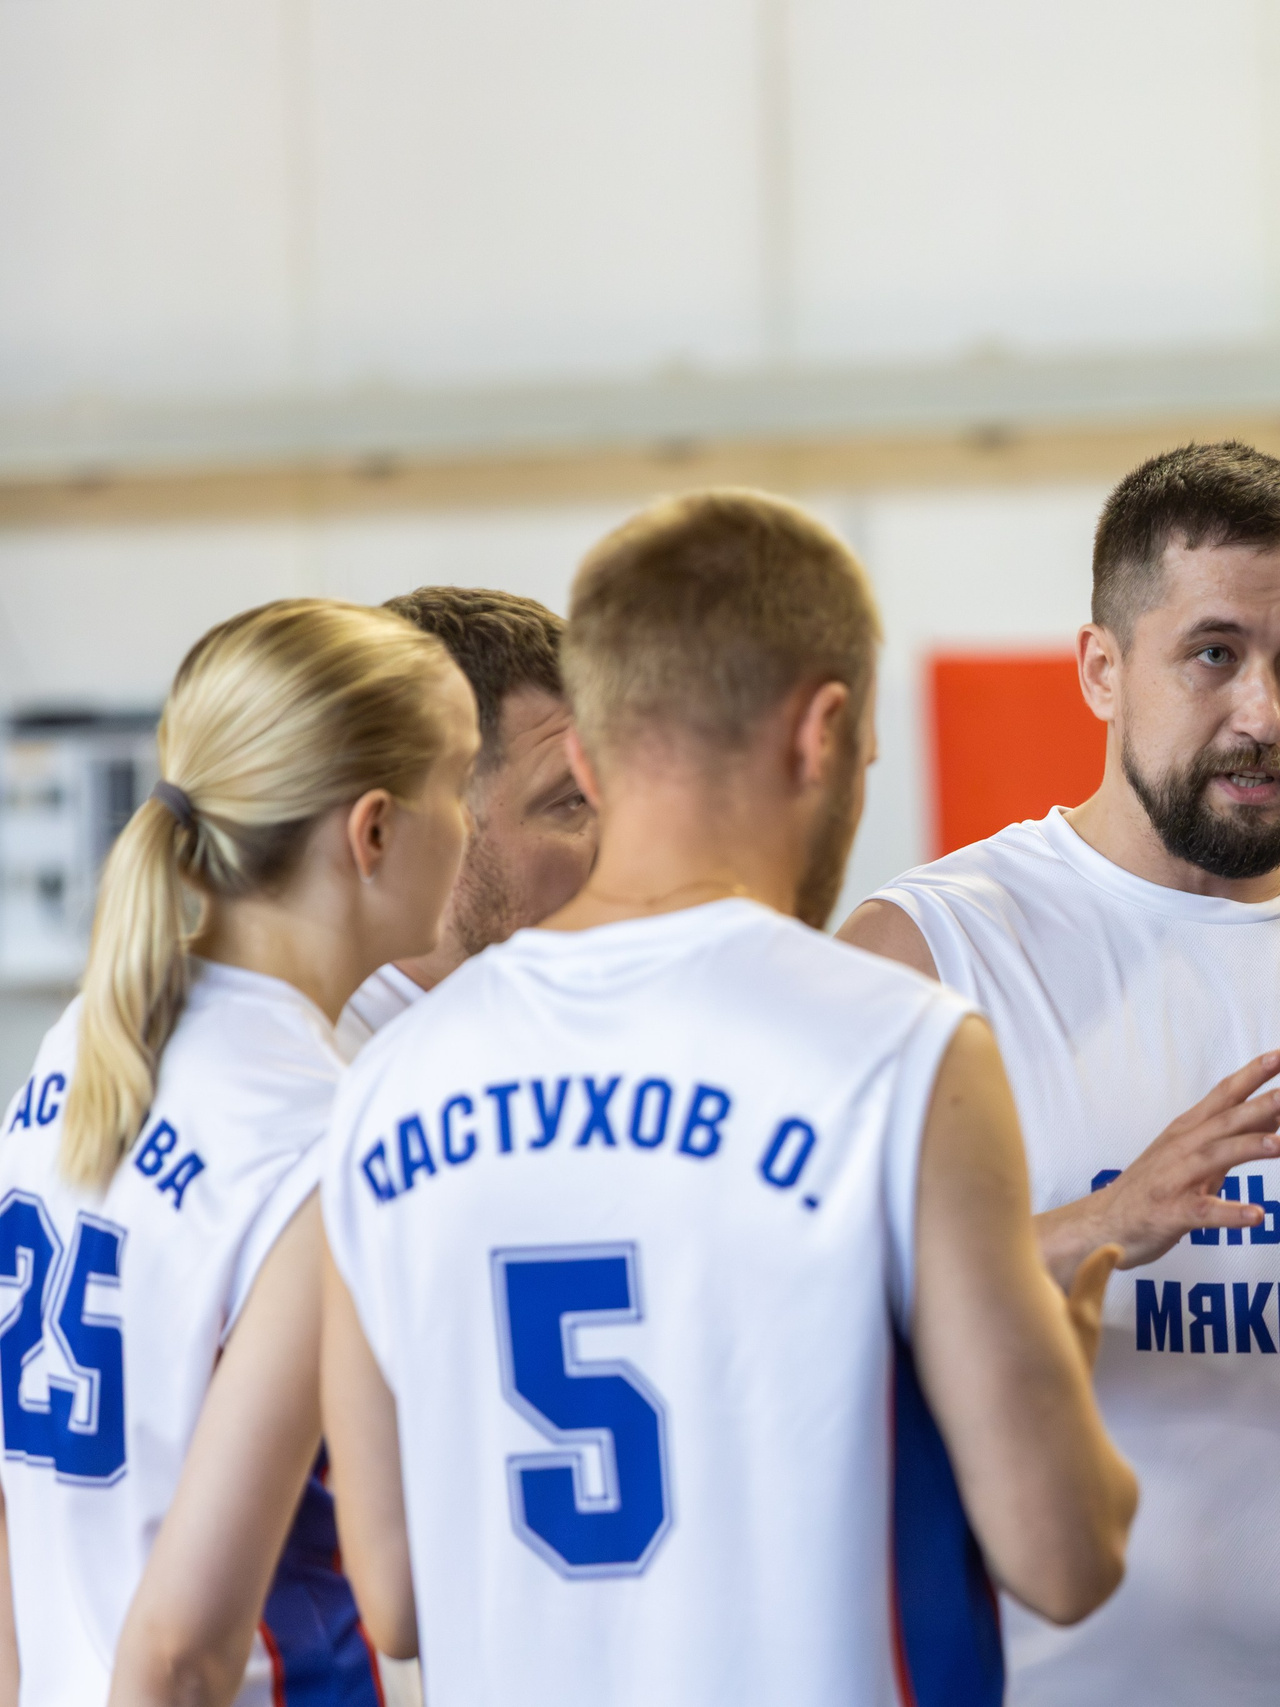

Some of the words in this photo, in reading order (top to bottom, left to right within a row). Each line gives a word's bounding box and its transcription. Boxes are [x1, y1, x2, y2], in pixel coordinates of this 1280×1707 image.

[361, 1076, 731, 1205] ПАСТУХОВ
[758, 1116, 819, 1210] О.
[0, 1188, 127, 1487] 25
[489, 1241, 673, 1581] 5
